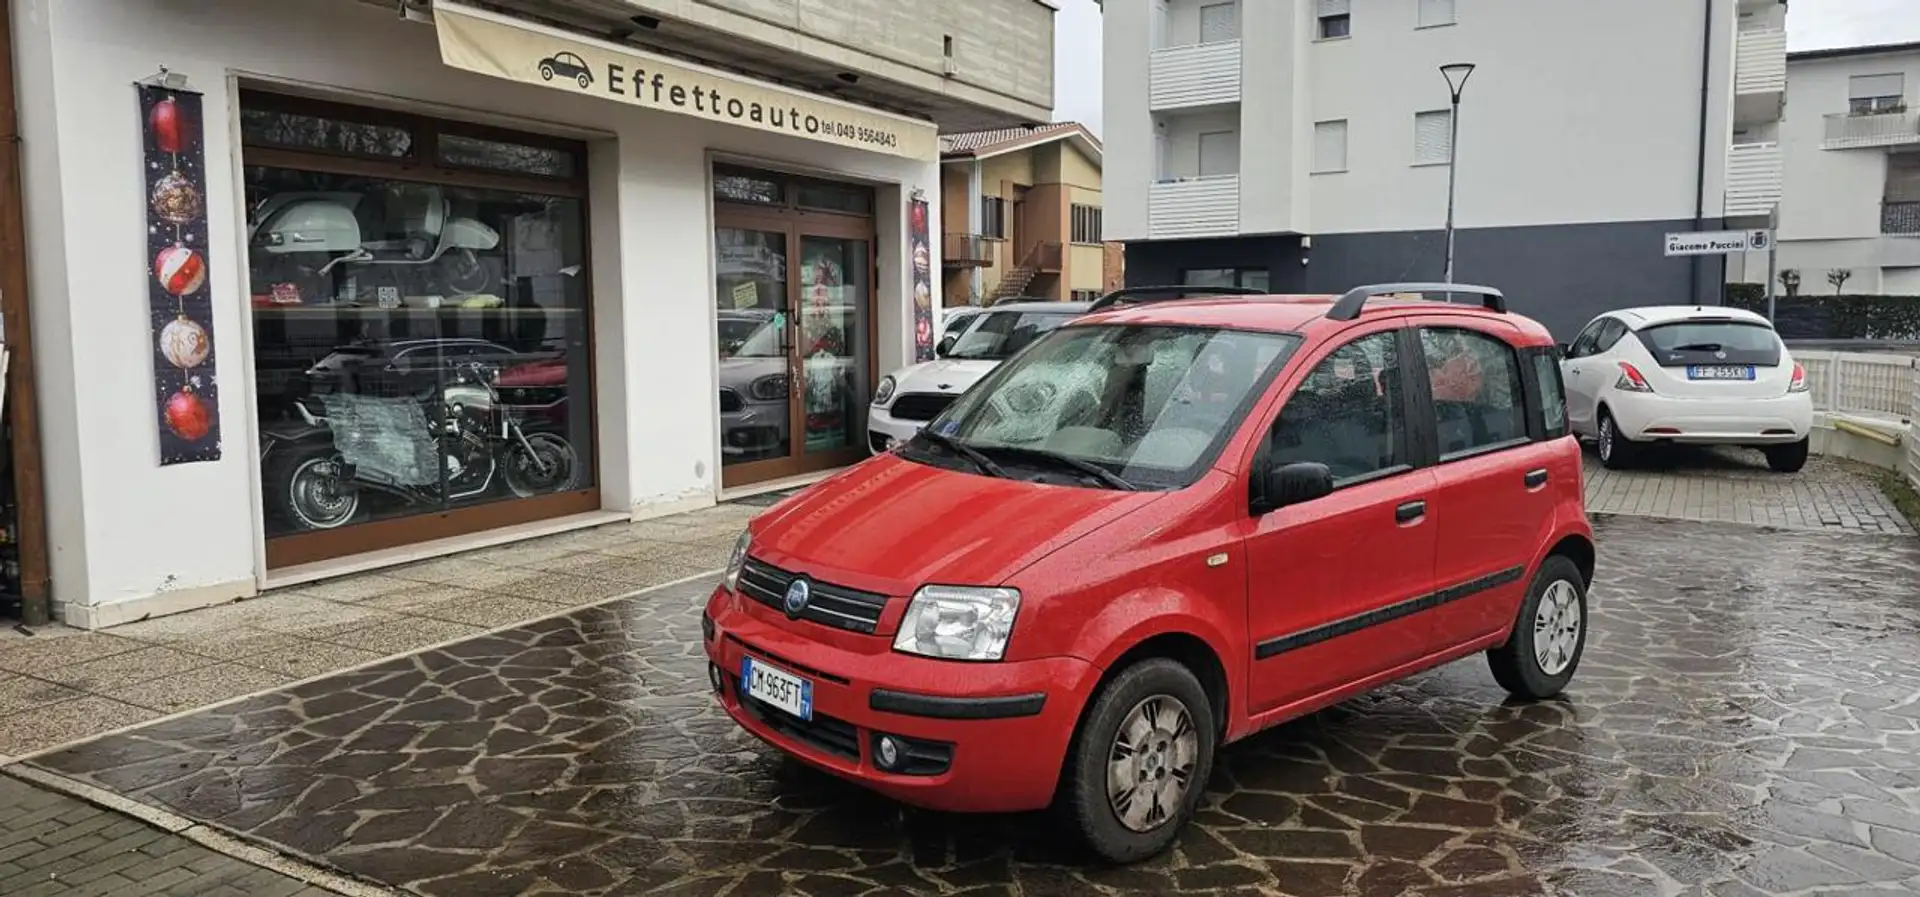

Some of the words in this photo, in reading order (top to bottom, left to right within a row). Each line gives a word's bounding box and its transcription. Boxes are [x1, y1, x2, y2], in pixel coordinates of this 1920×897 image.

[608, 63, 819, 134] Effettoauto
[857, 126, 897, 149] 9564843
[1669, 242, 1708, 251] Giacomo
[1710, 240, 1744, 249] Puccini
[751, 666, 764, 693] CM
[767, 673, 800, 708] 963FT
